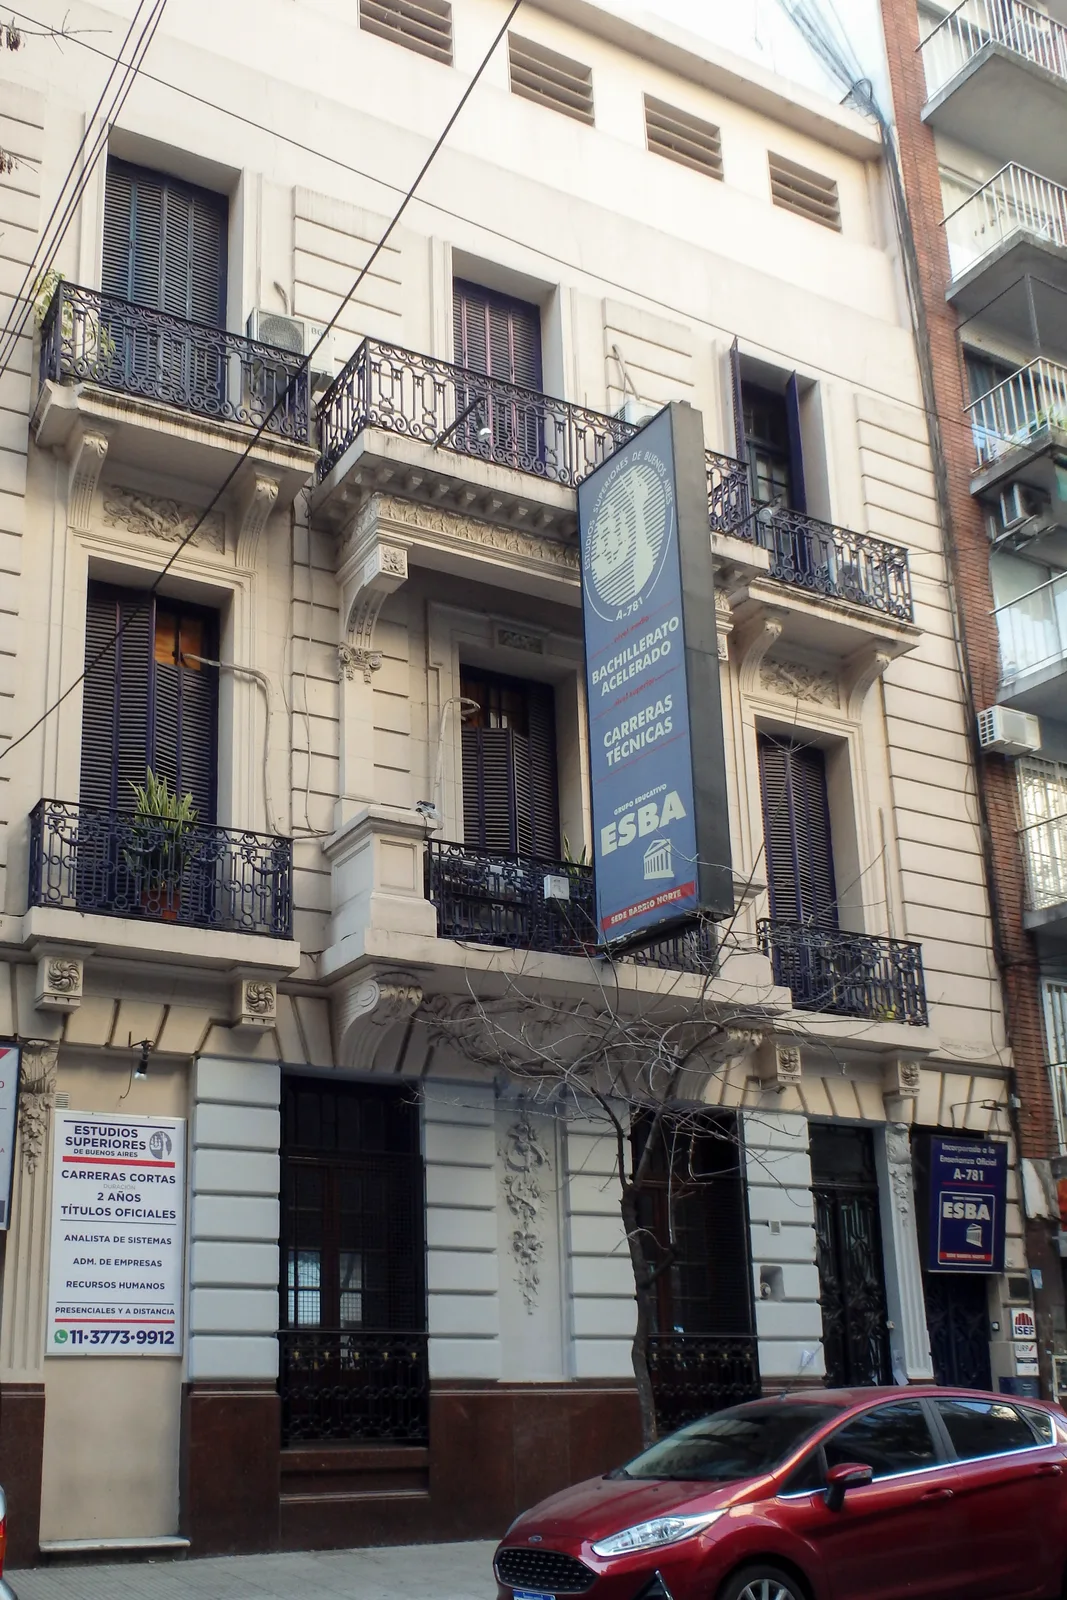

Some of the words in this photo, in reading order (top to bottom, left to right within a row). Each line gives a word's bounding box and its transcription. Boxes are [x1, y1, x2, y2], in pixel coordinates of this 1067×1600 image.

[585, 520, 595, 570] ESTUDIOS
[593, 457, 629, 513] SUPERIORES
[632, 450, 642, 462] DE
[644, 451, 667, 477] BUENOS
[662, 478, 673, 505] AIRES
[616, 596, 643, 621] A-781
[591, 616, 679, 685] BACHILLERATO
[601, 640, 671, 697] ACELERADO
[603, 694, 673, 748] CARRERAS
[605, 716, 673, 767] TÉCNICAS
[613, 798, 634, 816] GRUPO
[634, 783, 667, 804] EDUCATIVO
[600, 790, 687, 857] ESBA
[610, 910, 627, 924] SEDE
[628, 899, 656, 917] BARRIO
[656, 889, 682, 905] NORTE
[74, 1125, 139, 1138] ESTUDIOS
[65, 1136, 147, 1151] SUPERIORES
[61, 1169, 126, 1181] CARRERAS
[129, 1173, 176, 1184] CORTAS
[953, 1168, 984, 1181] A-781
[97, 1192, 104, 1201] 2
[107, 1190, 142, 1203] AÑOS
[61, 1203, 112, 1216] TÍTULOS
[115, 1208, 176, 1219] OFICIALES
[943, 1201, 990, 1221] ESBA
[64, 1234, 111, 1243] ANALISTA
[128, 1236, 172, 1245] SISTEMAS
[73, 1257, 97, 1265] ADM.
[99, 1258, 112, 1266] DE
[114, 1259, 162, 1267] EMPRESAS
[66, 1280, 117, 1289] RECURSOS
[119, 1282, 165, 1290] HUMANOS
[55, 1306, 116, 1314] PRESENCIALES
[1015, 1326, 1035, 1336] ISEF
